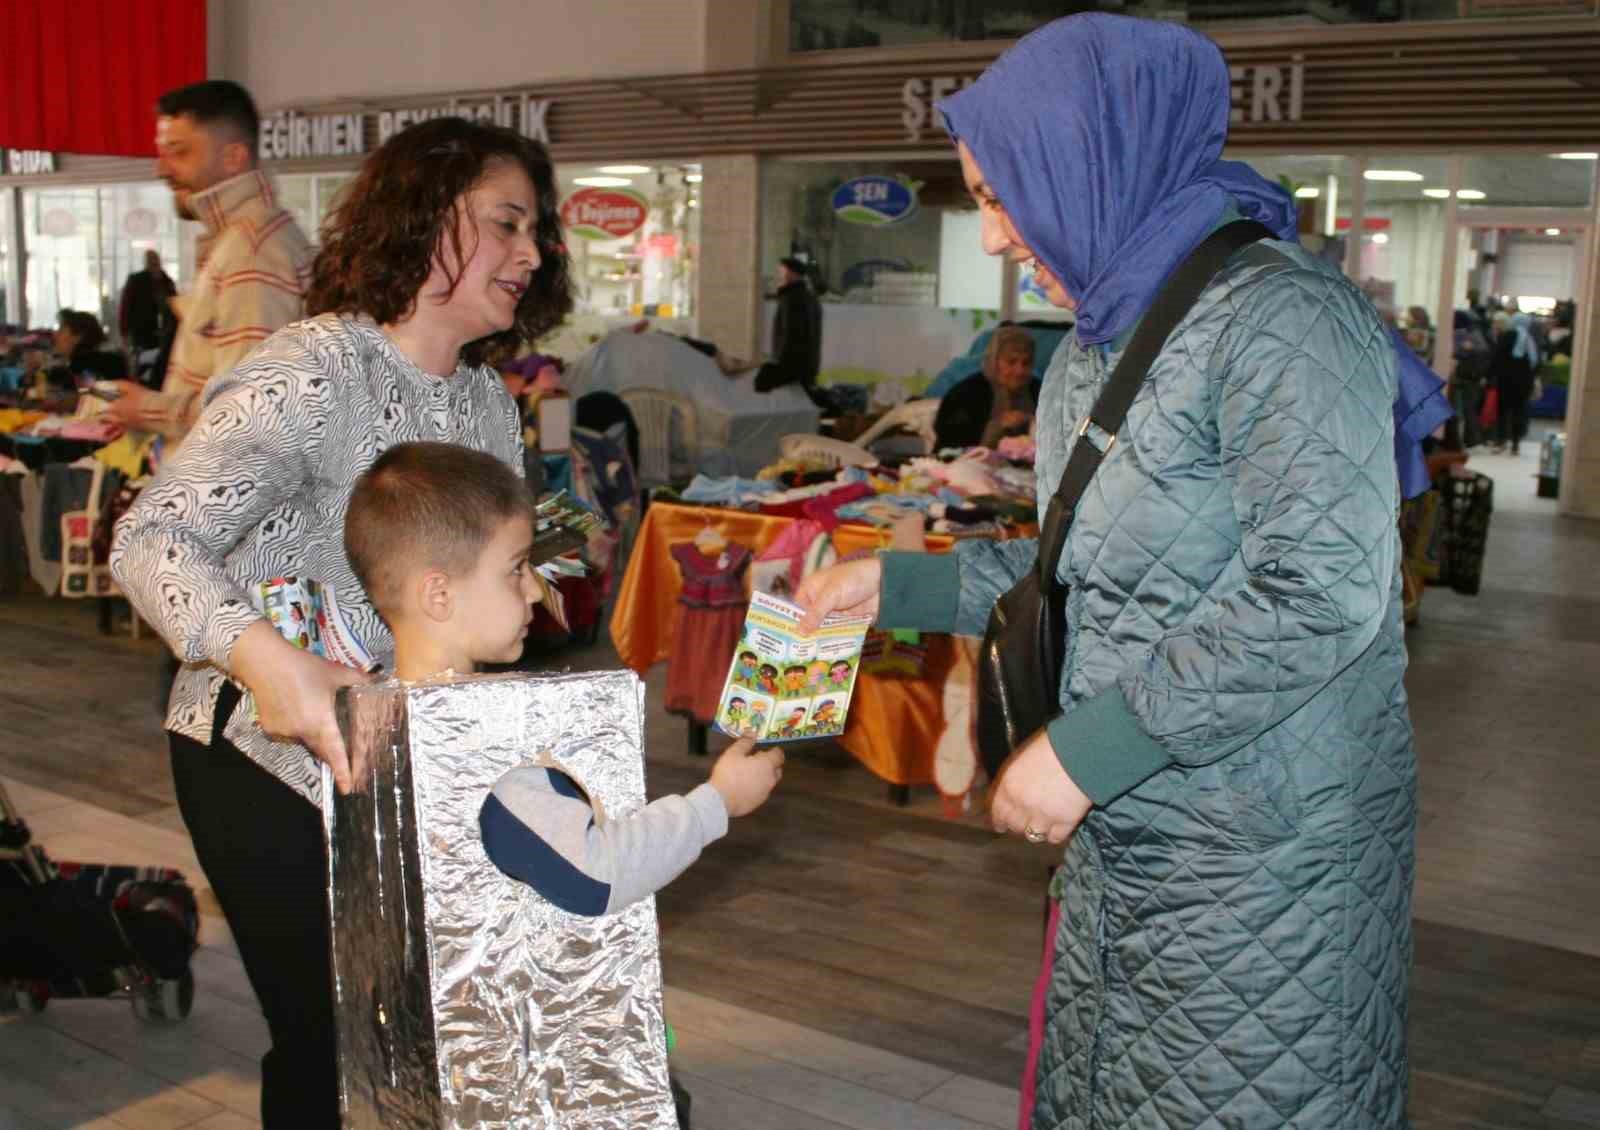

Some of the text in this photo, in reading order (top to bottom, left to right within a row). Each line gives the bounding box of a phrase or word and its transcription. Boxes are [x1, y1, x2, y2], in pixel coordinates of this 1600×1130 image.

[902, 53, 1304, 142] ŞE ERİ
[258, 109, 366, 159] EĞİRMEN
